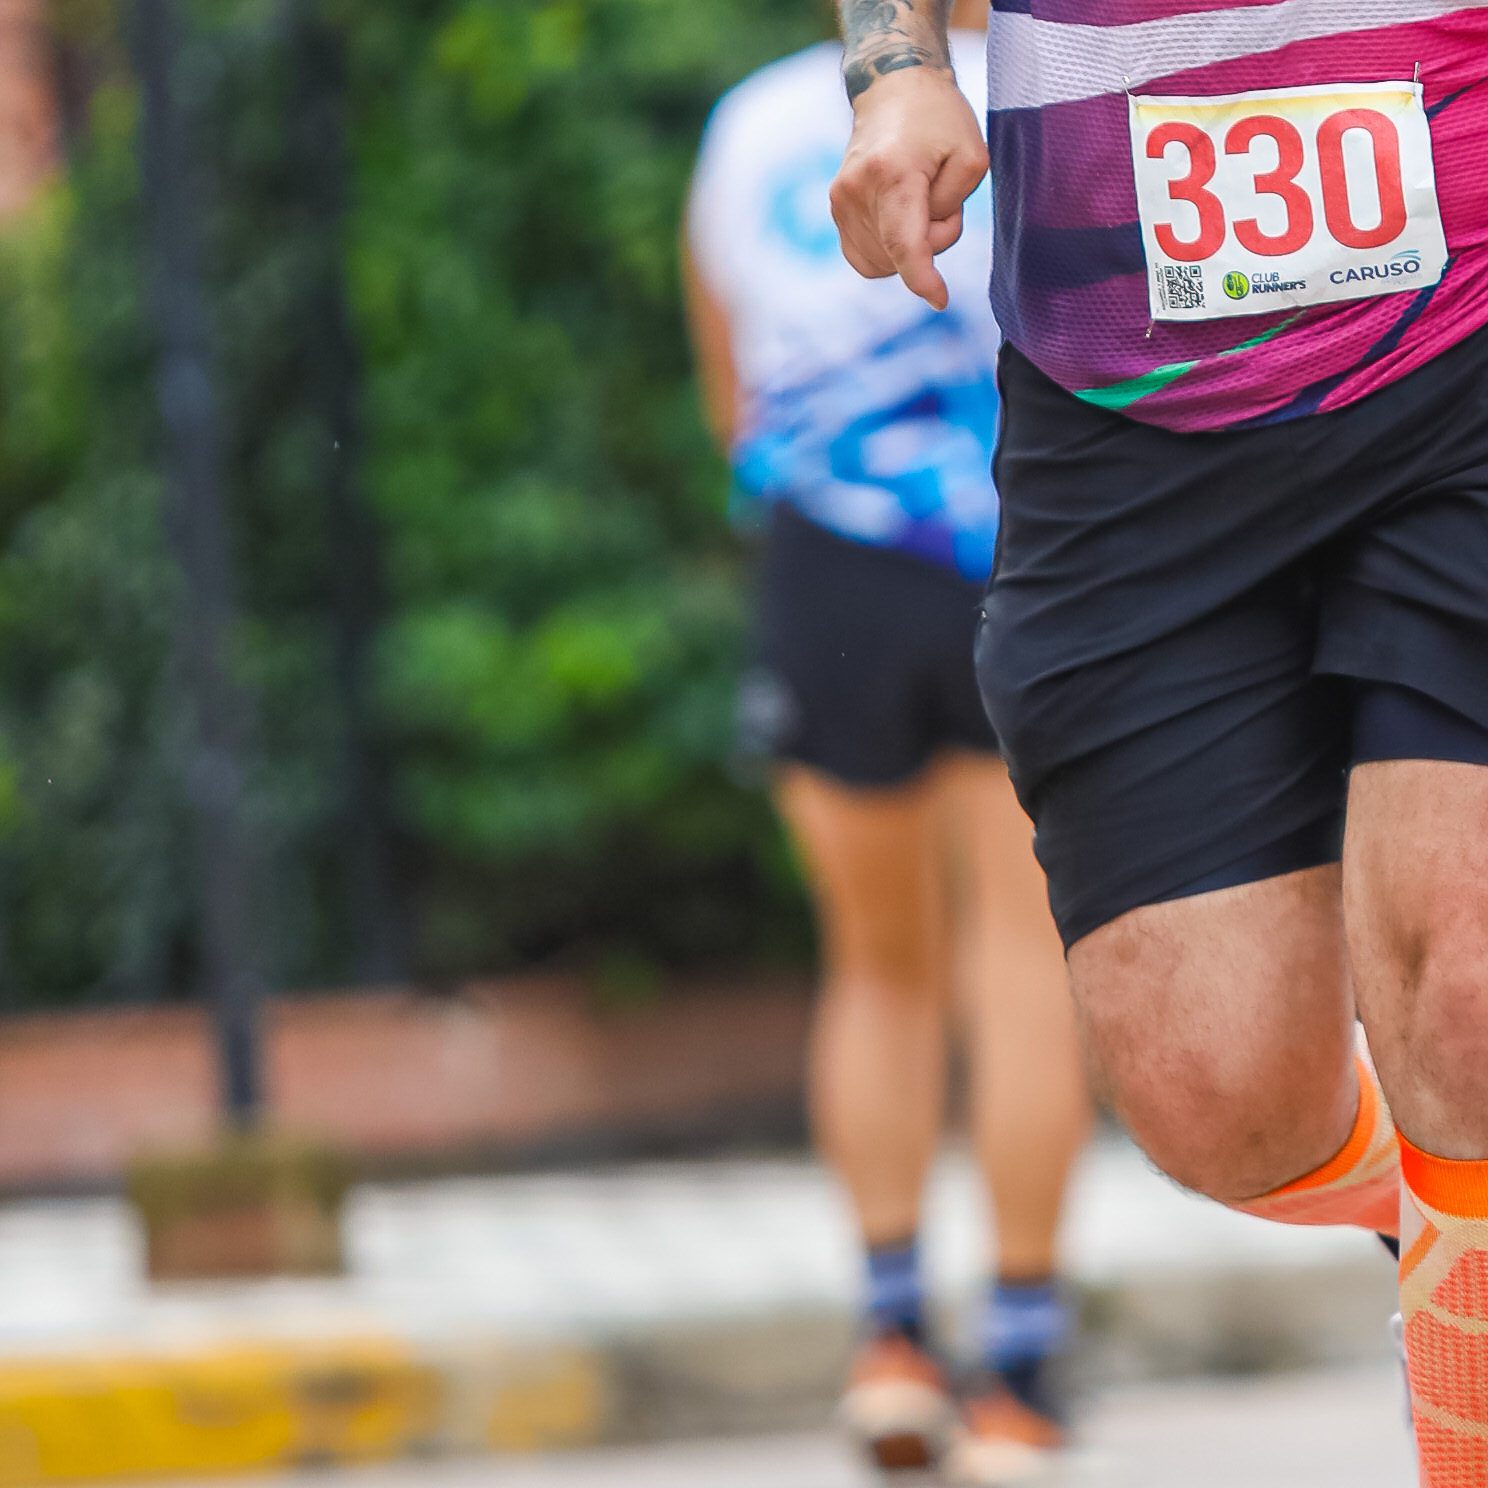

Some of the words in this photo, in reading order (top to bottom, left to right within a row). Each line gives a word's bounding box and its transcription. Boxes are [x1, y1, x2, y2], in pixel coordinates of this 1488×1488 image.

[1146, 108, 1407, 262] 330
[1251, 272, 1280, 284] CLUB
[1329, 259, 1420, 285] CARUSO
[1251, 279, 1307, 295] RUNNER'S
